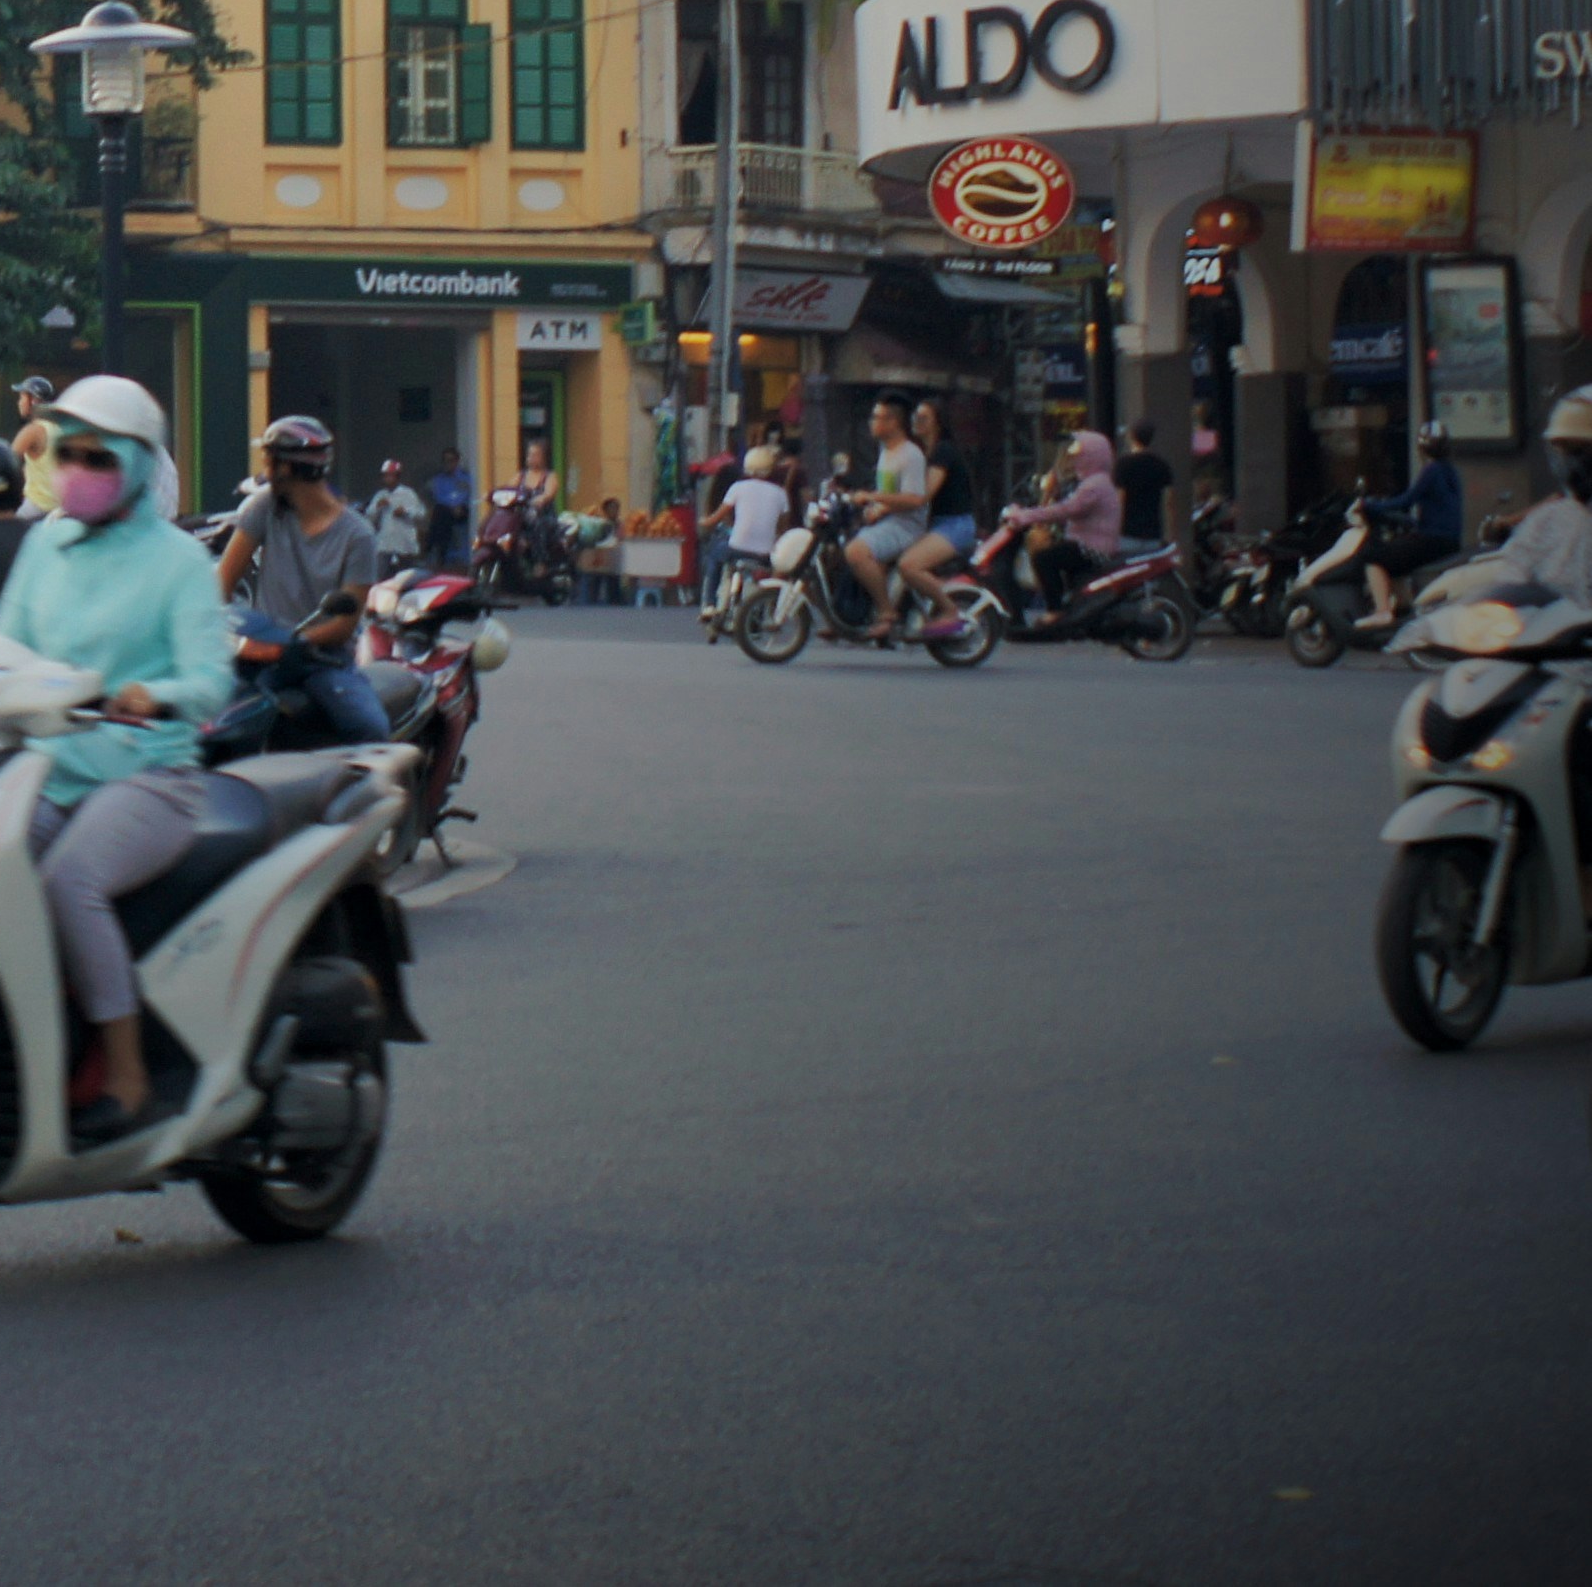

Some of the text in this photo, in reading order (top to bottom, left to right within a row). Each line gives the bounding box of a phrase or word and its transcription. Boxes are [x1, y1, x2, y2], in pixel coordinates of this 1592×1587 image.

[937, 142, 1066, 189] HIGHLANDS
[952, 214, 1052, 243] COFFEE
[355, 267, 520, 297] Vietcombank
[530, 320, 590, 341] ATM
